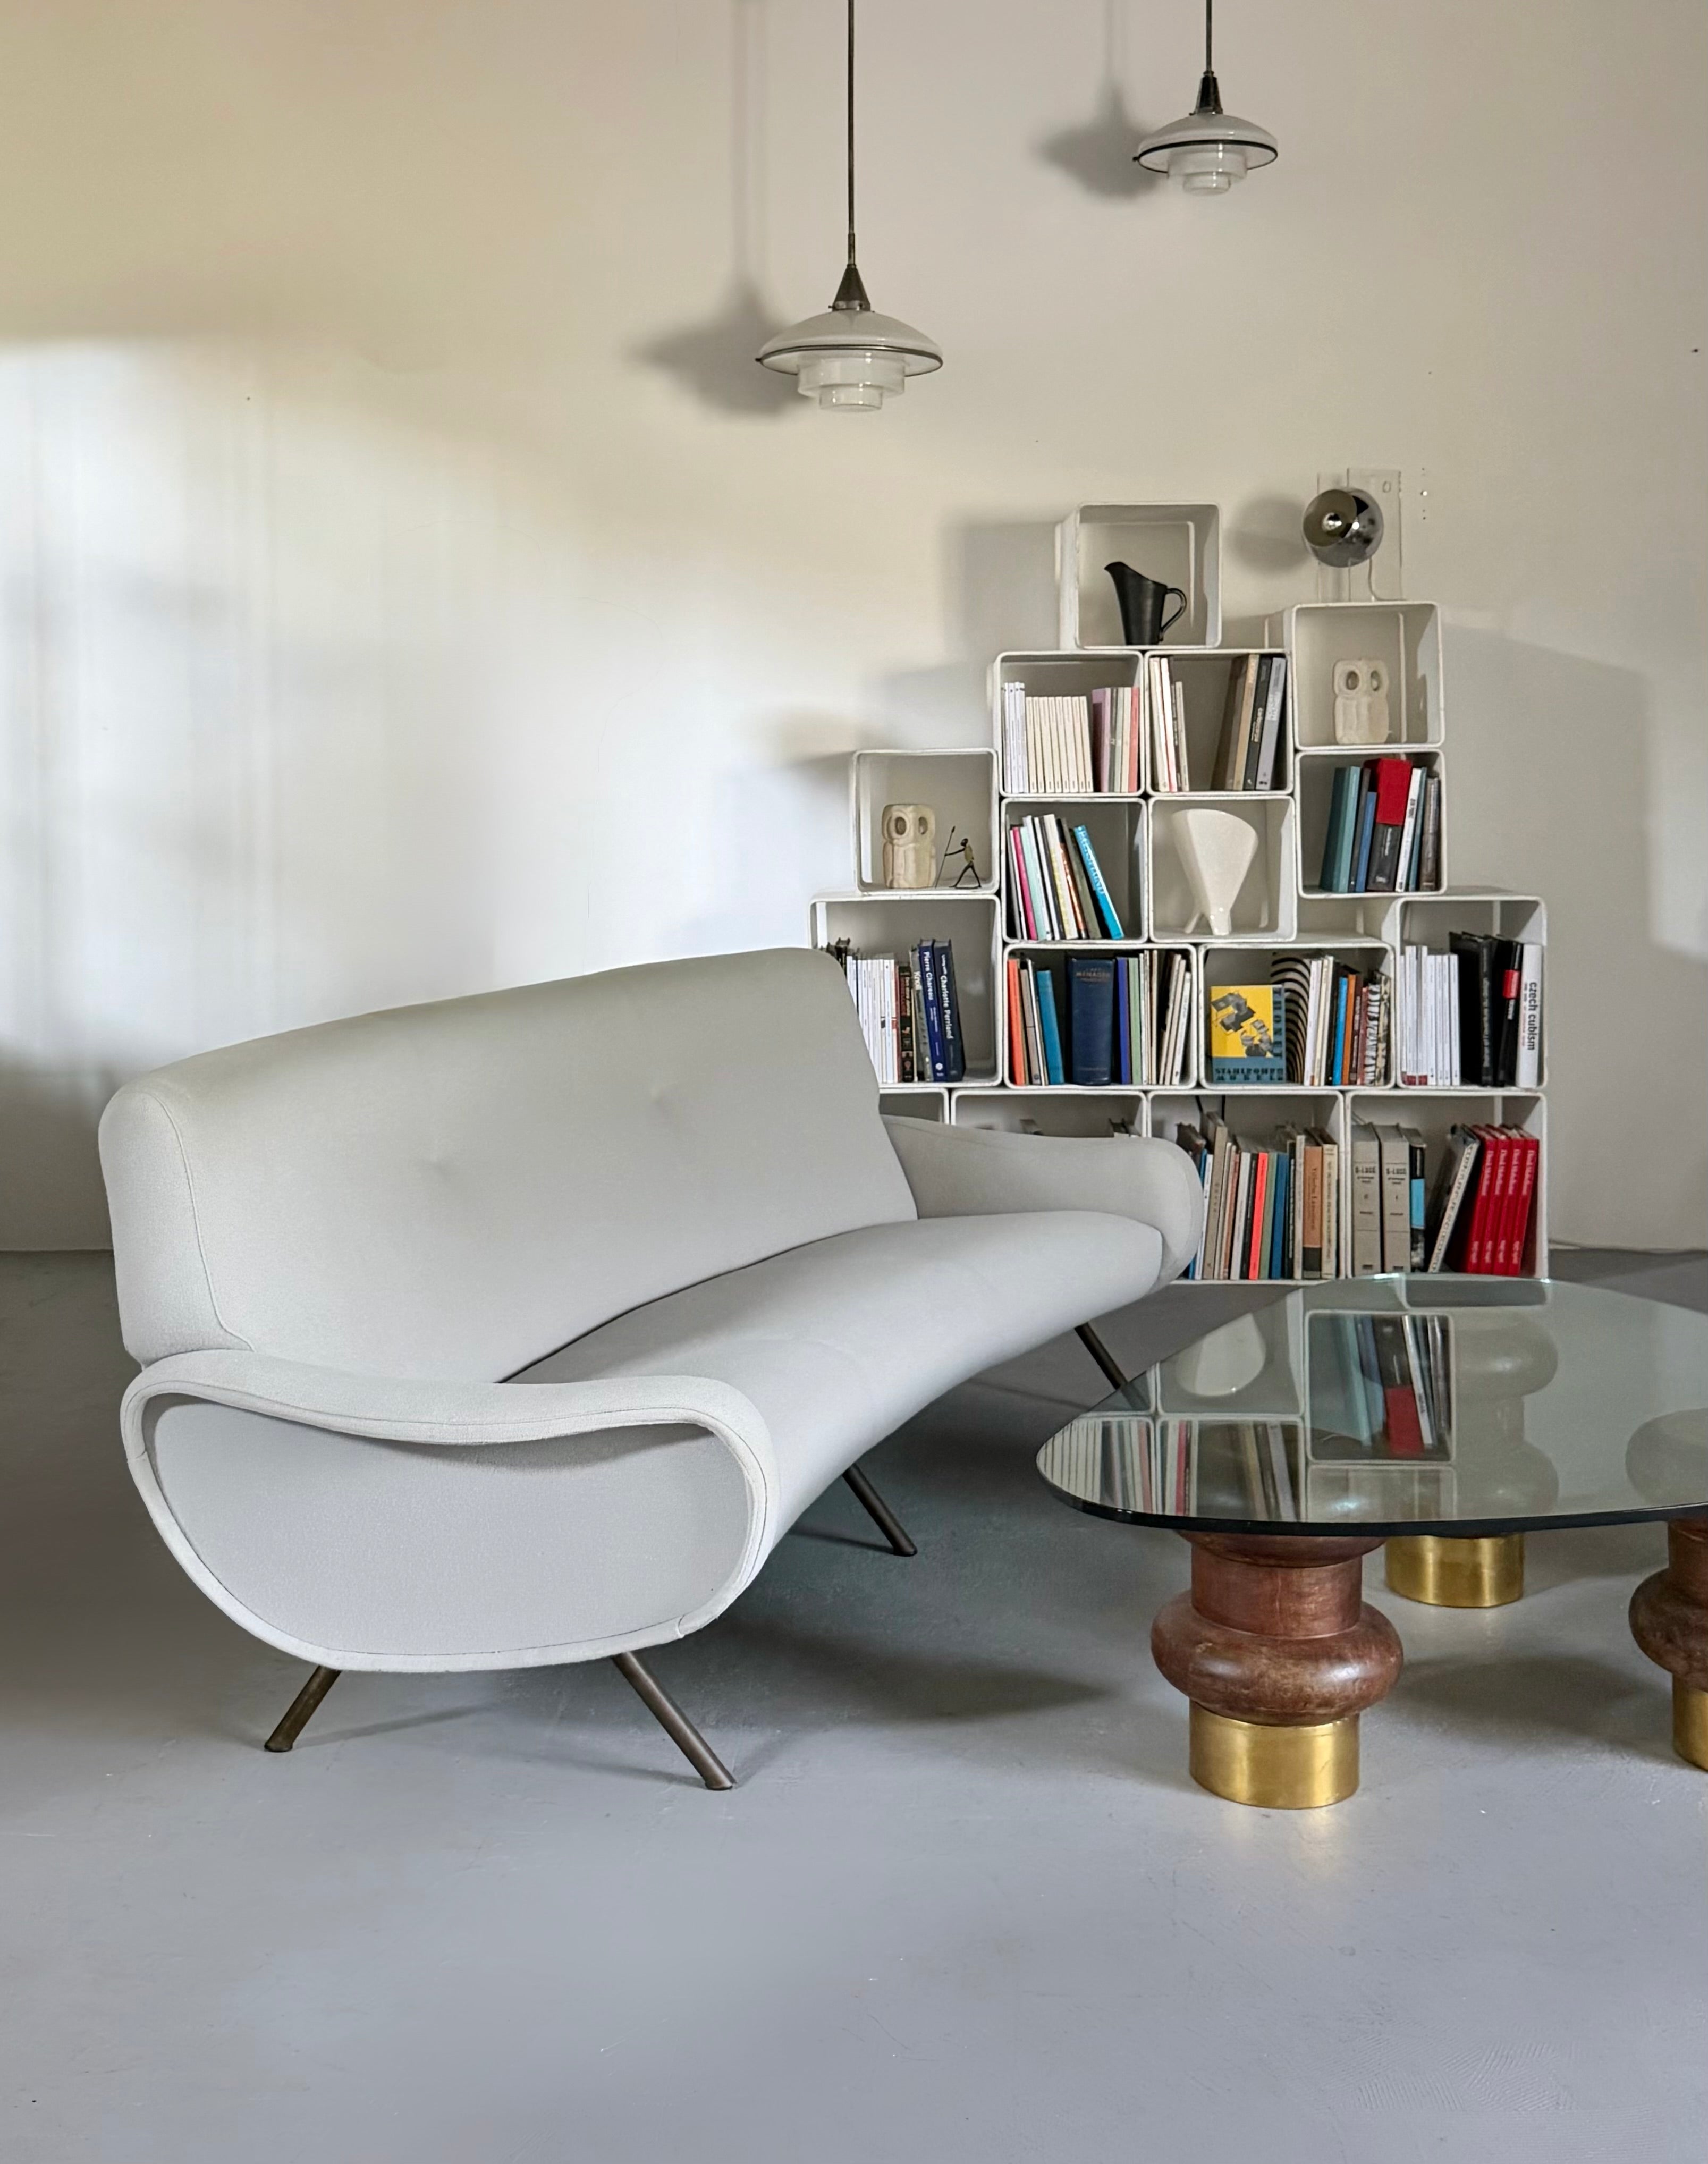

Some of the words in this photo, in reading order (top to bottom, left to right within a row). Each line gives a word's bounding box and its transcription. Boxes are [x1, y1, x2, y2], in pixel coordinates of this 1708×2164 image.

[925, 972, 934, 1001] Chareau
[940, 975, 950, 1008] Charlotte
[1528, 982, 1538, 1011] czech
[944, 1009, 954, 1039] Perriand
[1273, 988, 1282, 1058] THONET
[1527, 1014, 1537, 1051] cubism
